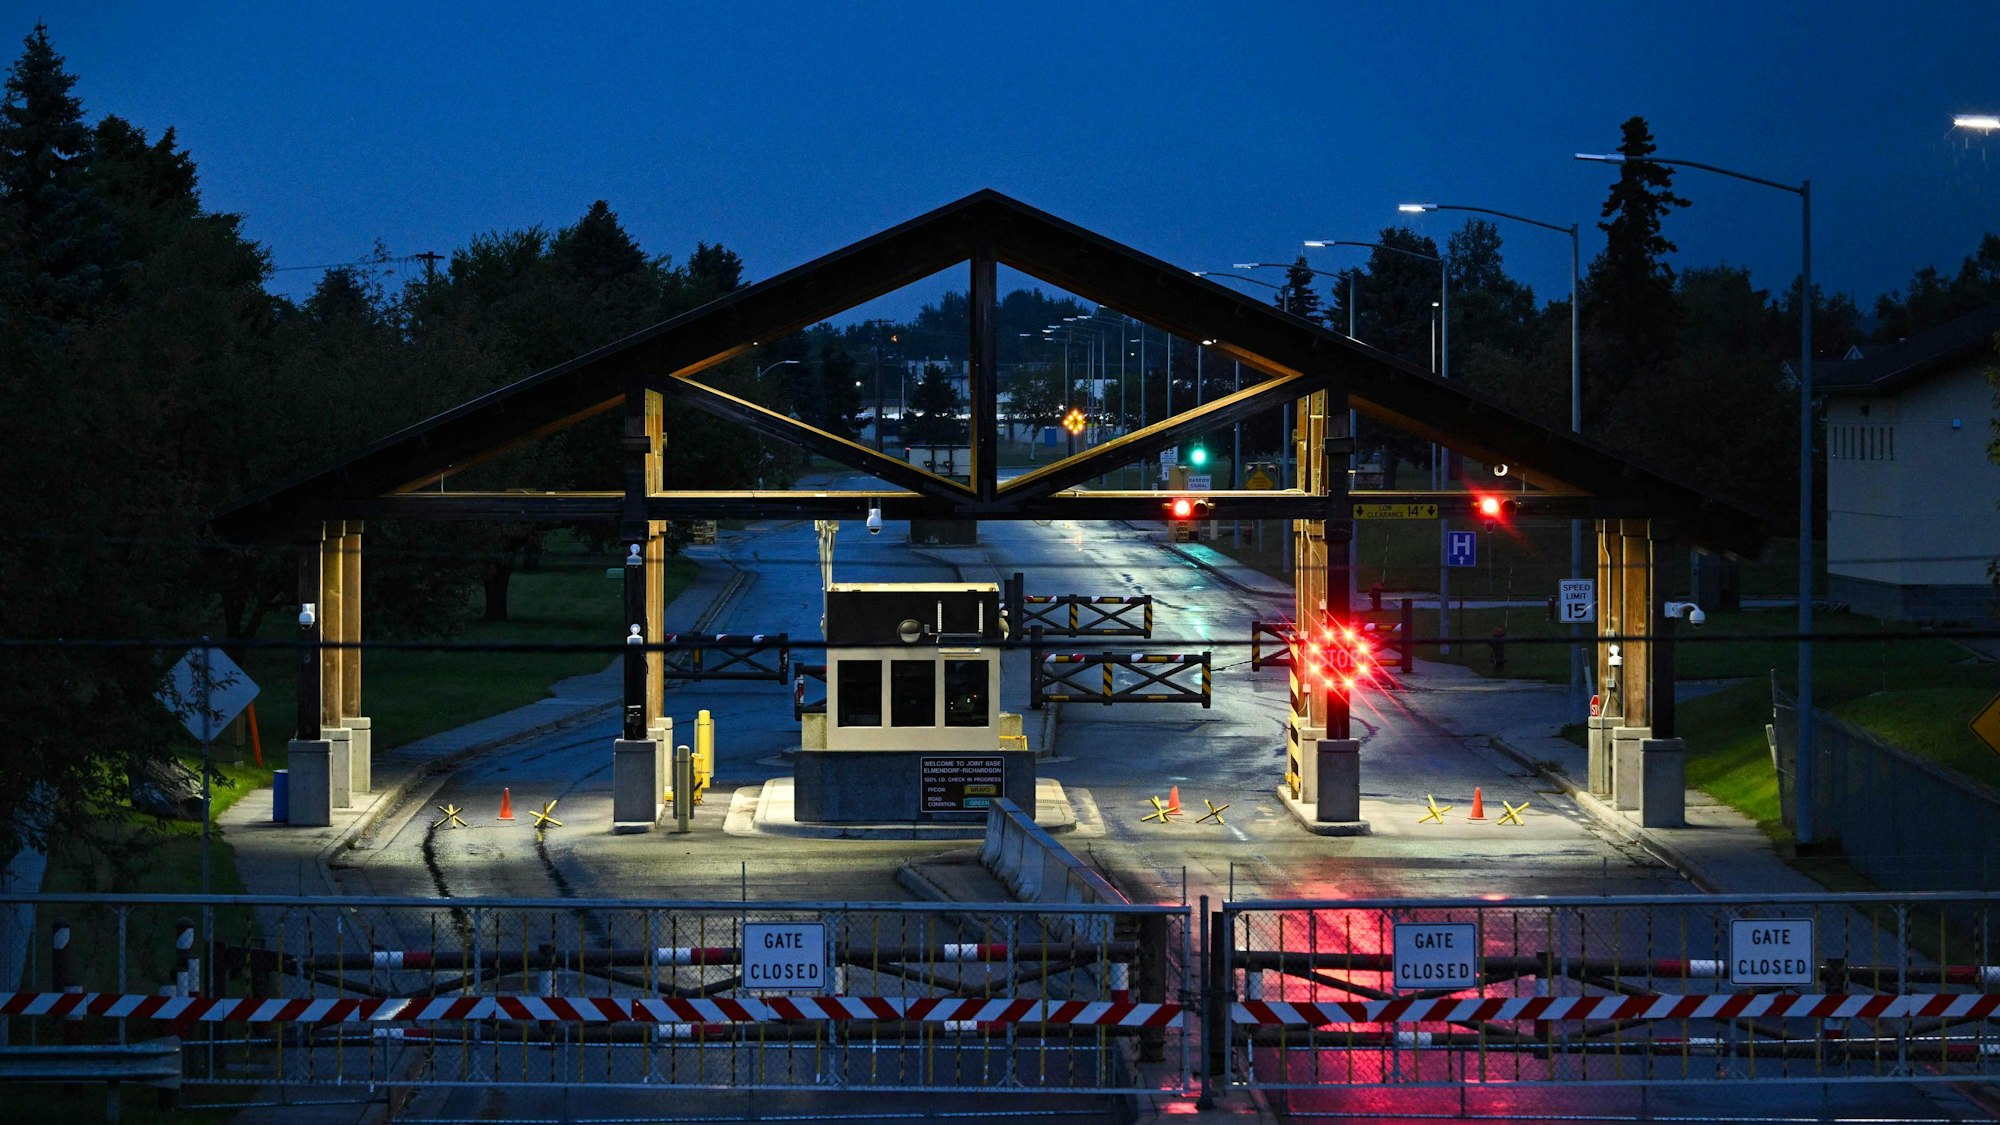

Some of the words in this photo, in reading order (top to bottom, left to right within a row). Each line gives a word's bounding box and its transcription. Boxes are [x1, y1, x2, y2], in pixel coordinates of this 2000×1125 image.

[1453, 534, 1470, 556] H
[1565, 592, 1586, 600] LIMIT
[1567, 603, 1587, 618] 15
[1320, 650, 1360, 667] STOP
[764, 932, 803, 949] GATE
[1415, 932, 1454, 949] GATE
[1752, 929, 1791, 945] GATE
[750, 963, 818, 980] CLOSED
[1401, 963, 1469, 980] CLOSED
[1738, 959, 1806, 975] CLOSED
